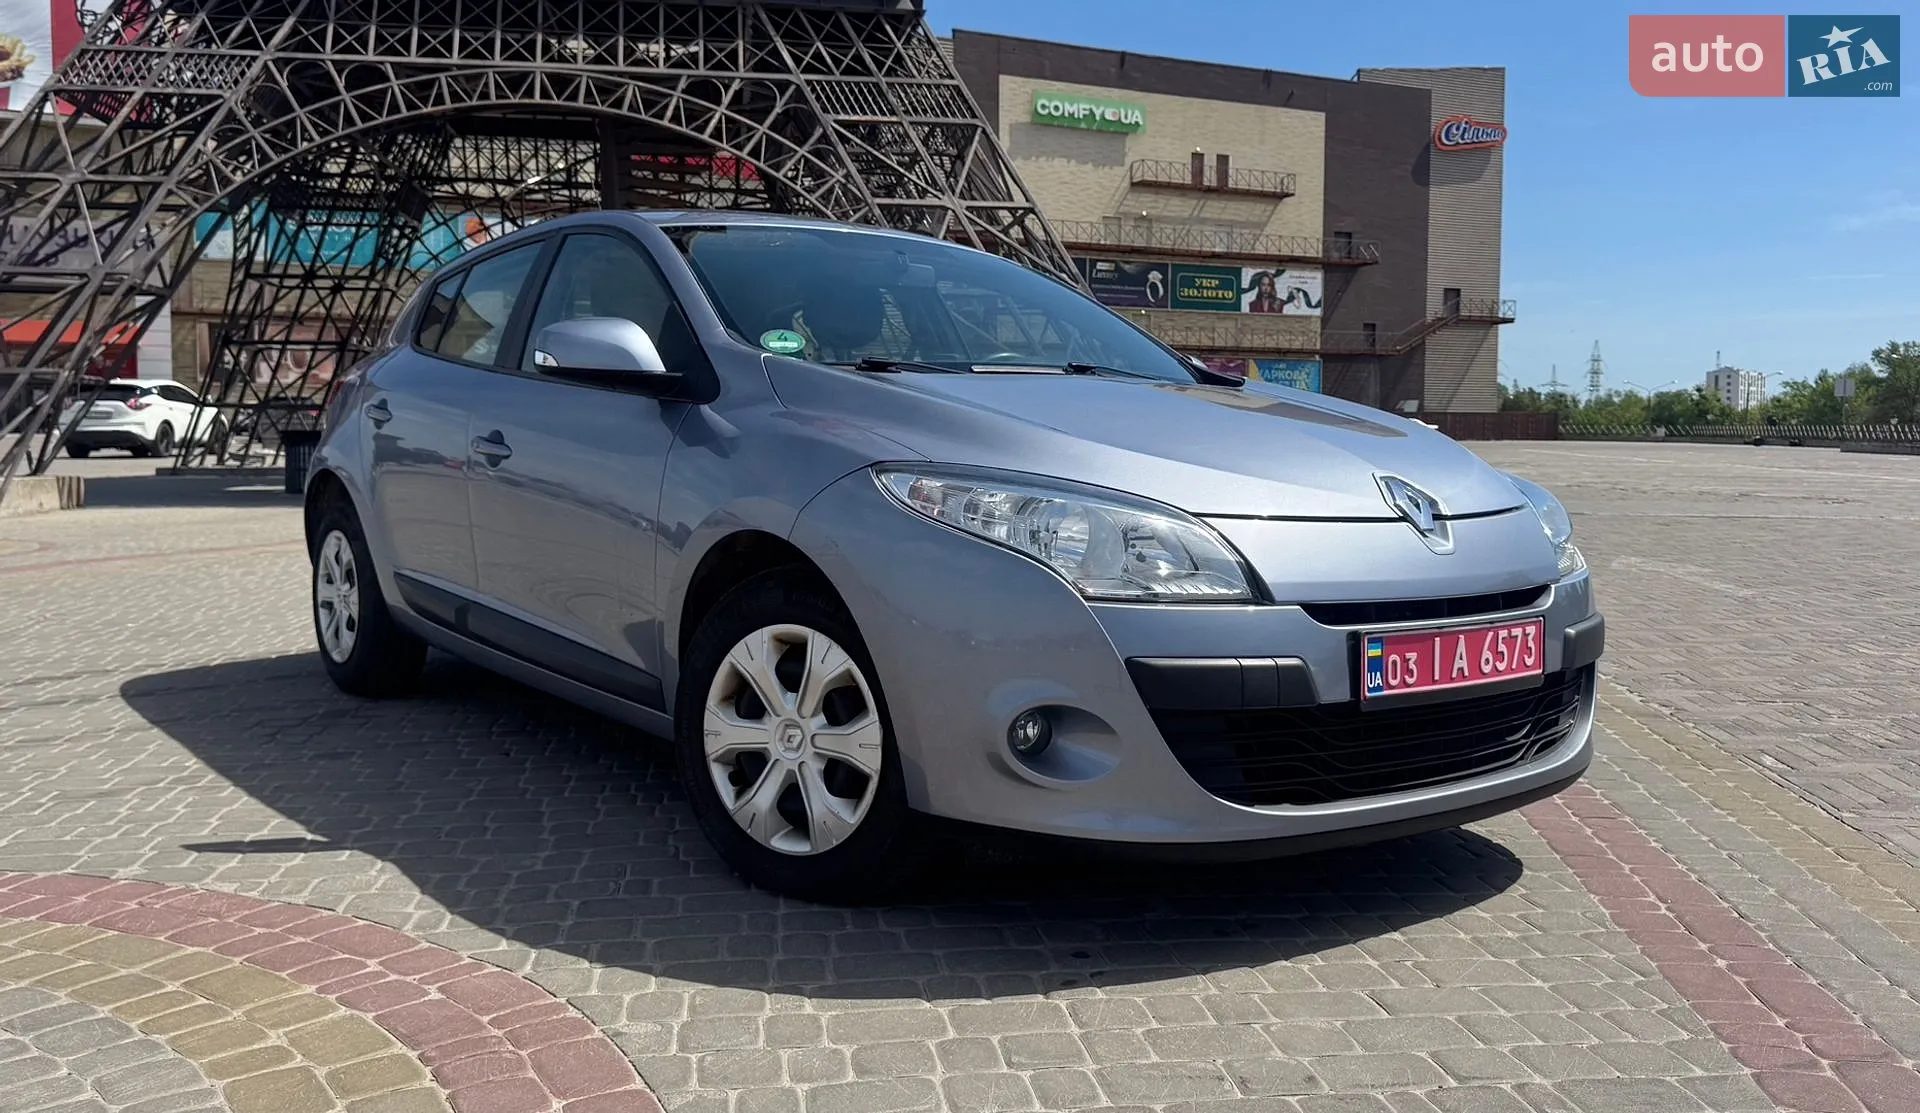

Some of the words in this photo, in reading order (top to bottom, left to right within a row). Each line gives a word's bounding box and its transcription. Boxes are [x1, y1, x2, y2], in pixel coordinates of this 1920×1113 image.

[1036, 99, 1104, 121] COMFY
[1194, 277, 1220, 288] УКР
[1180, 287, 1233, 299] ЗОЛОТО
[775, 332, 788, 341] 4
[1388, 652, 1418, 686] 03
[1481, 625, 1536, 674] 6573
[1367, 672, 1383, 687] UA
